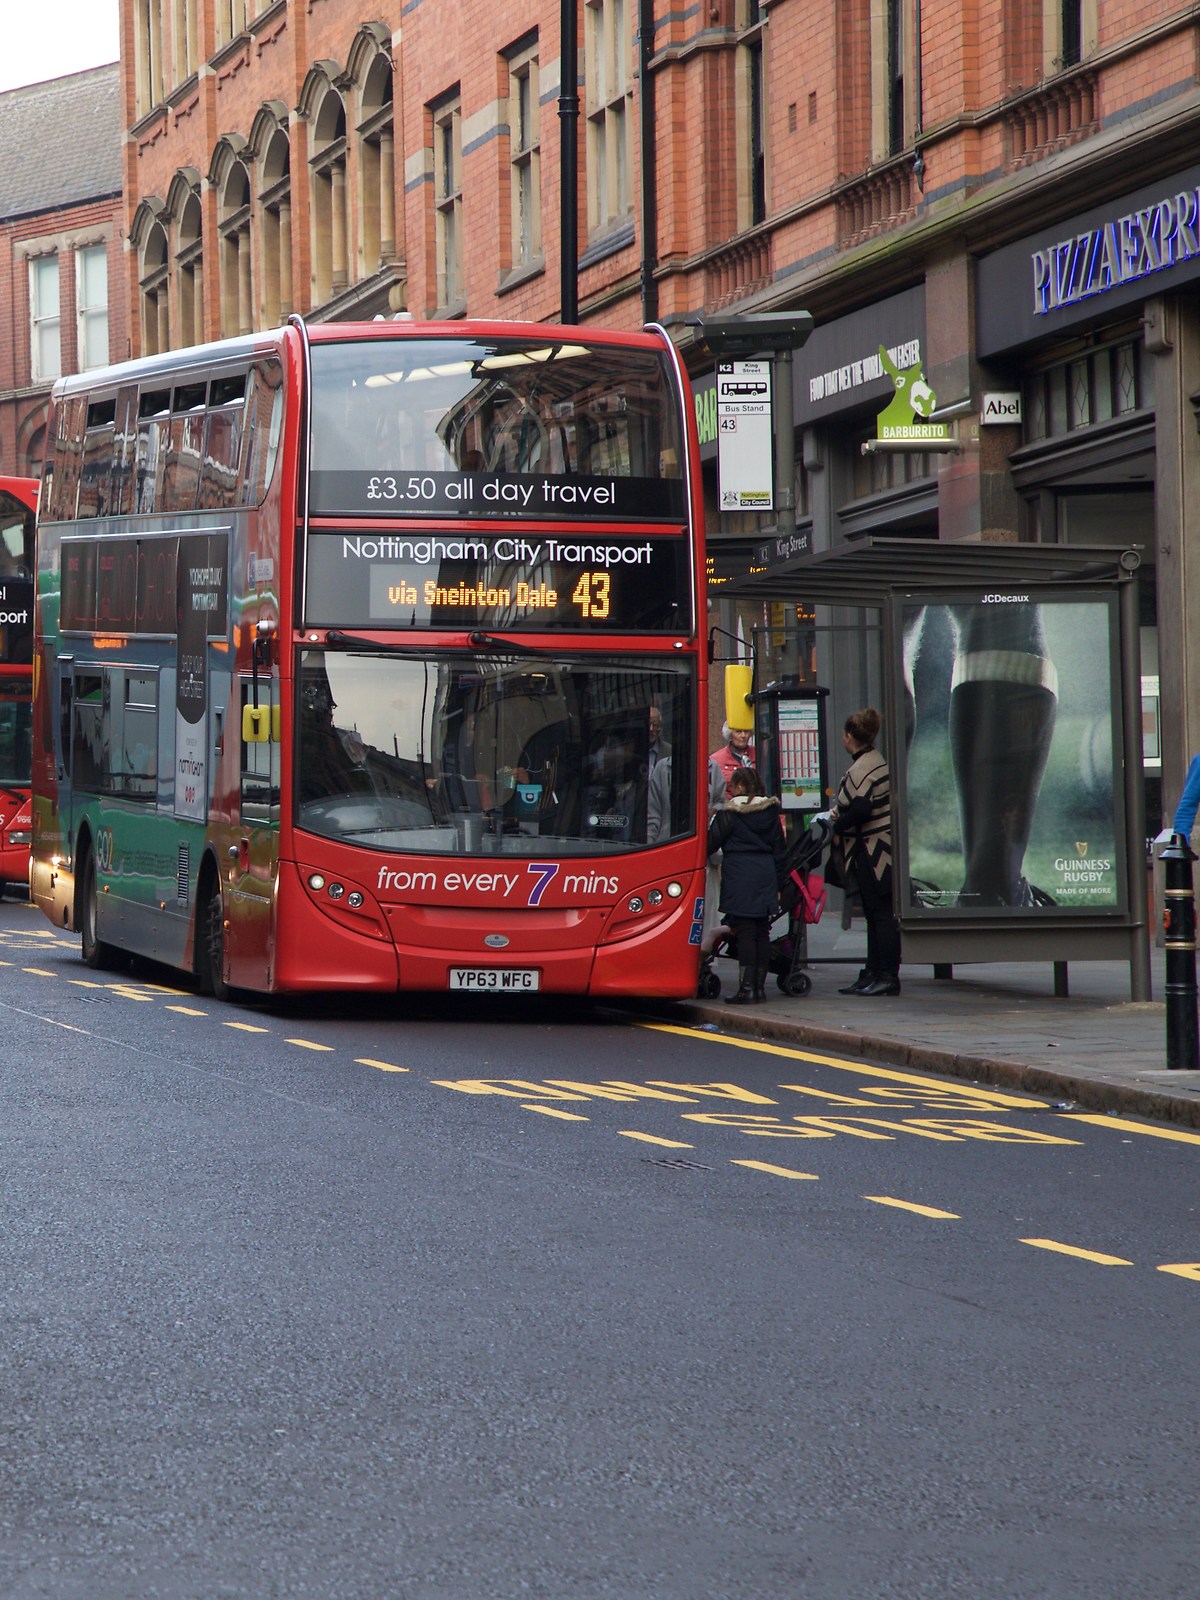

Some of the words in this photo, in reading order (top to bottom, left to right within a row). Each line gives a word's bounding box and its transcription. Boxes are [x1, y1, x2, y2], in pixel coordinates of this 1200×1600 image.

[1032, 186, 1200, 315] PIZZAEXPR
[719, 364, 732, 372] K2
[824, 369, 839, 397] THAT
[851, 359, 863, 387] THE
[725, 405, 740, 413] Bus
[742, 404, 764, 412] Stand
[986, 400, 1020, 415] Abel
[721, 420, 736, 430] 43
[883, 425, 944, 438] BARBURRITO
[366, 477, 437, 500] £3.50
[444, 478, 474, 500] all
[482, 479, 535, 506] day
[542, 480, 616, 504] travel
[342, 537, 488, 564] Nottingham
[494, 538, 541, 566] City
[546, 540, 653, 568] Transport
[776, 538, 790, 559] King
[790, 535, 808, 552] Street
[388, 580, 417, 605] via
[423, 581, 511, 606] Sneinton
[516, 583, 558, 607] Dale
[572, 572, 611, 618] 43
[981, 594, 1029, 604] JCDecaux
[1054, 858, 1111, 871] GUINNESS
[376, 866, 437, 891] from
[443, 873, 520, 897] every
[526, 863, 560, 906] 7
[563, 870, 619, 894] mins
[1064, 871, 1104, 882] RUGBY
[456, 971, 498, 987] YP63
[501, 972, 532, 988] WFG
